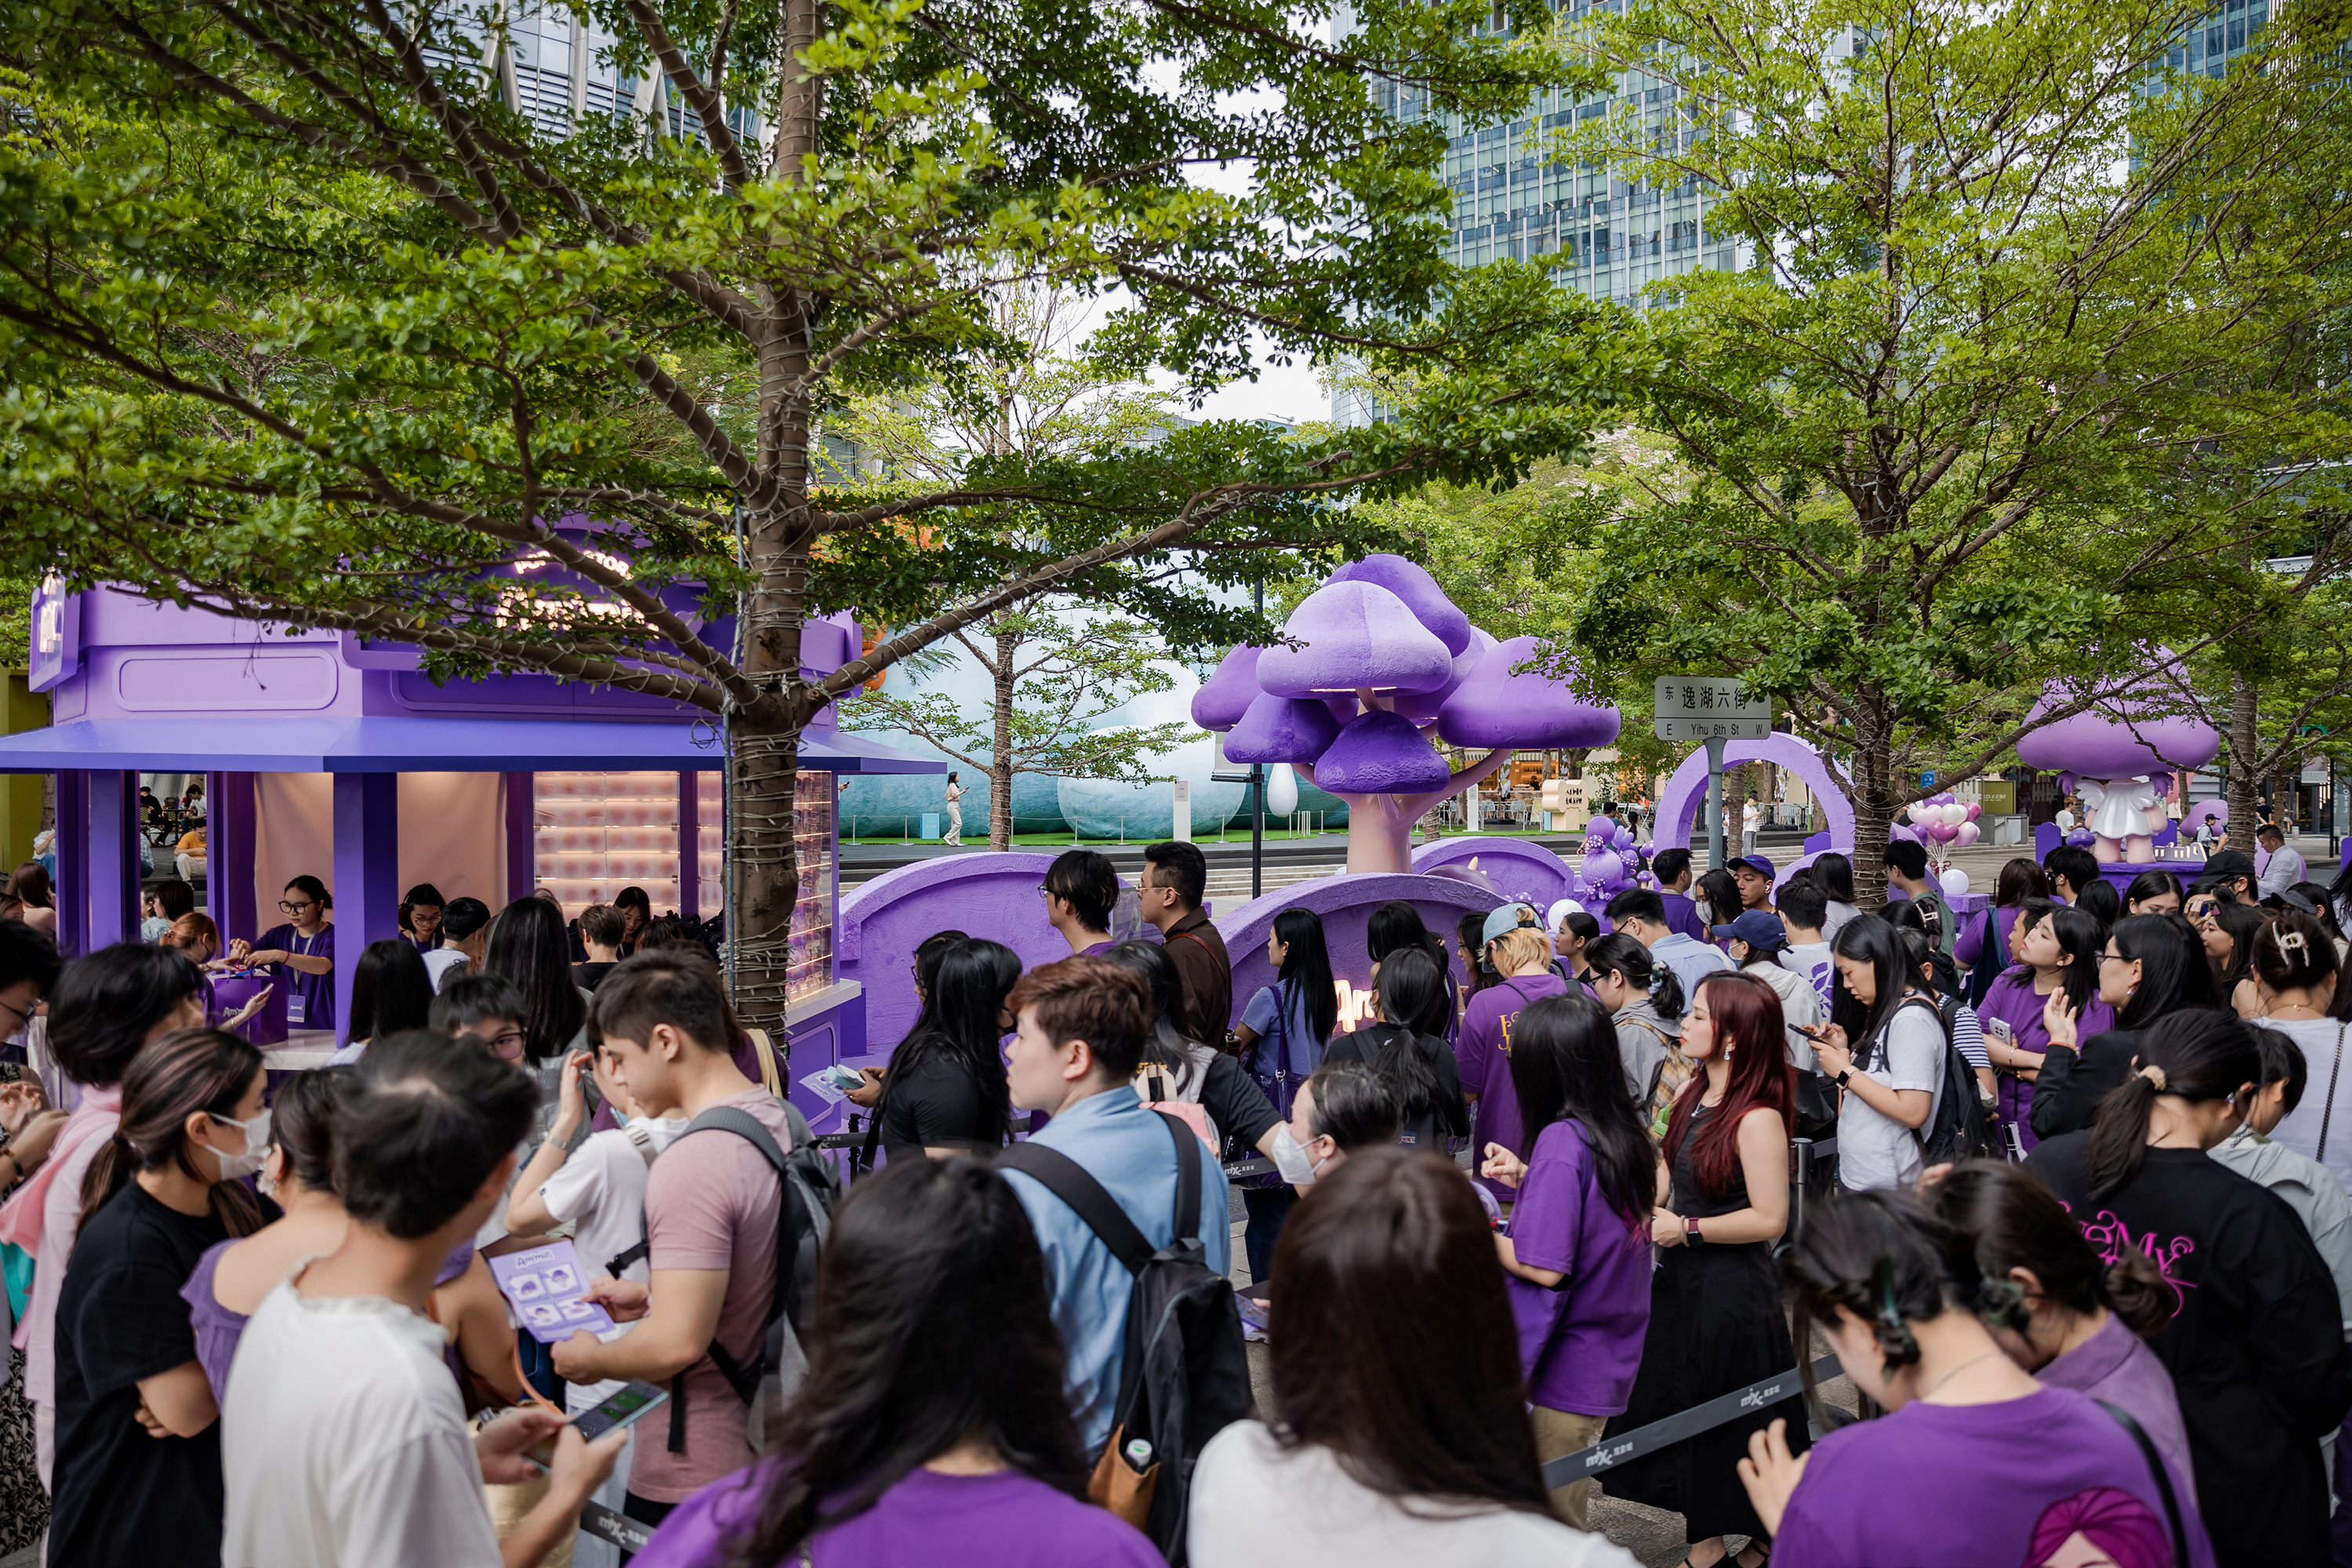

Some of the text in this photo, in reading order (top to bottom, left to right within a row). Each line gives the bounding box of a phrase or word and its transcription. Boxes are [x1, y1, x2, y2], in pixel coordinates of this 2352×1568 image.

[1665, 685, 1746, 710] 东 逸湖六街
[1667, 724, 1762, 735] E Yihu 6th St W
